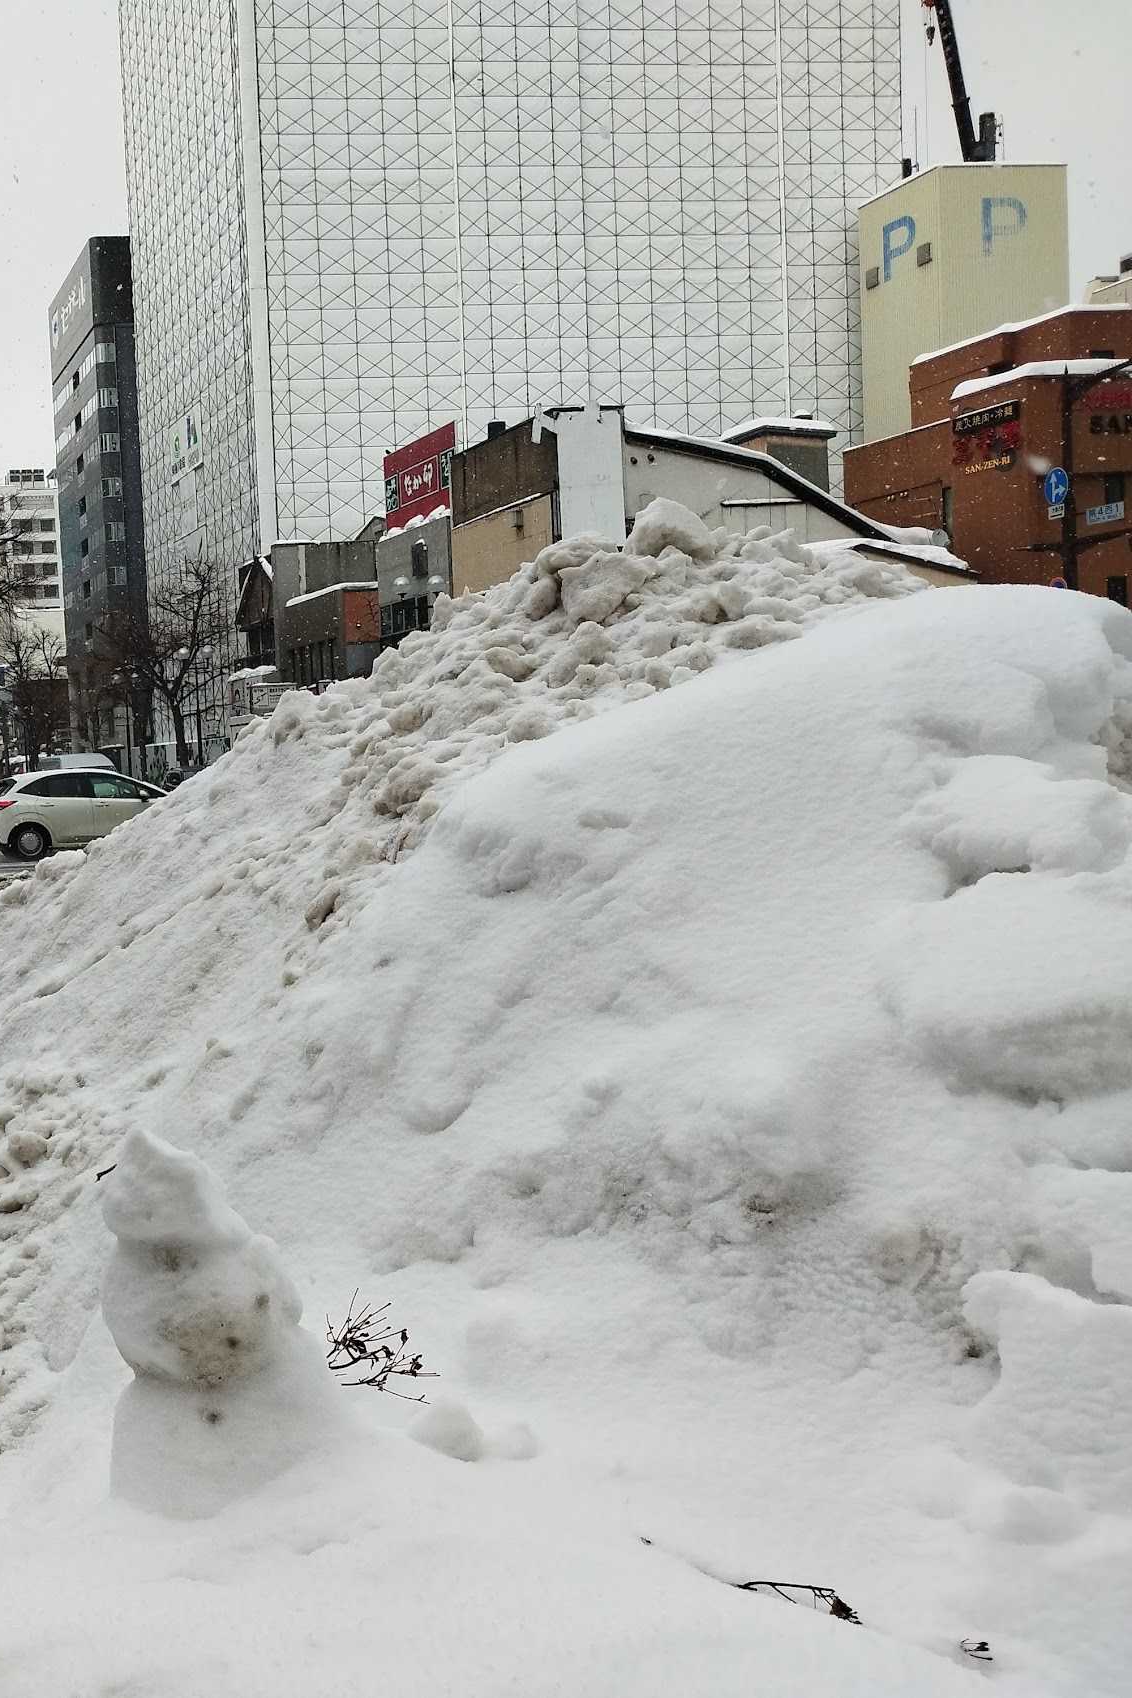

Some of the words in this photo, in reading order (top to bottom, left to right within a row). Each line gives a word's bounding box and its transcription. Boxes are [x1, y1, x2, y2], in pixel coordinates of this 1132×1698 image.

[883, 215, 916, 283] P
[982, 197, 1027, 257] P
[404, 462, 433, 496] なか卯
